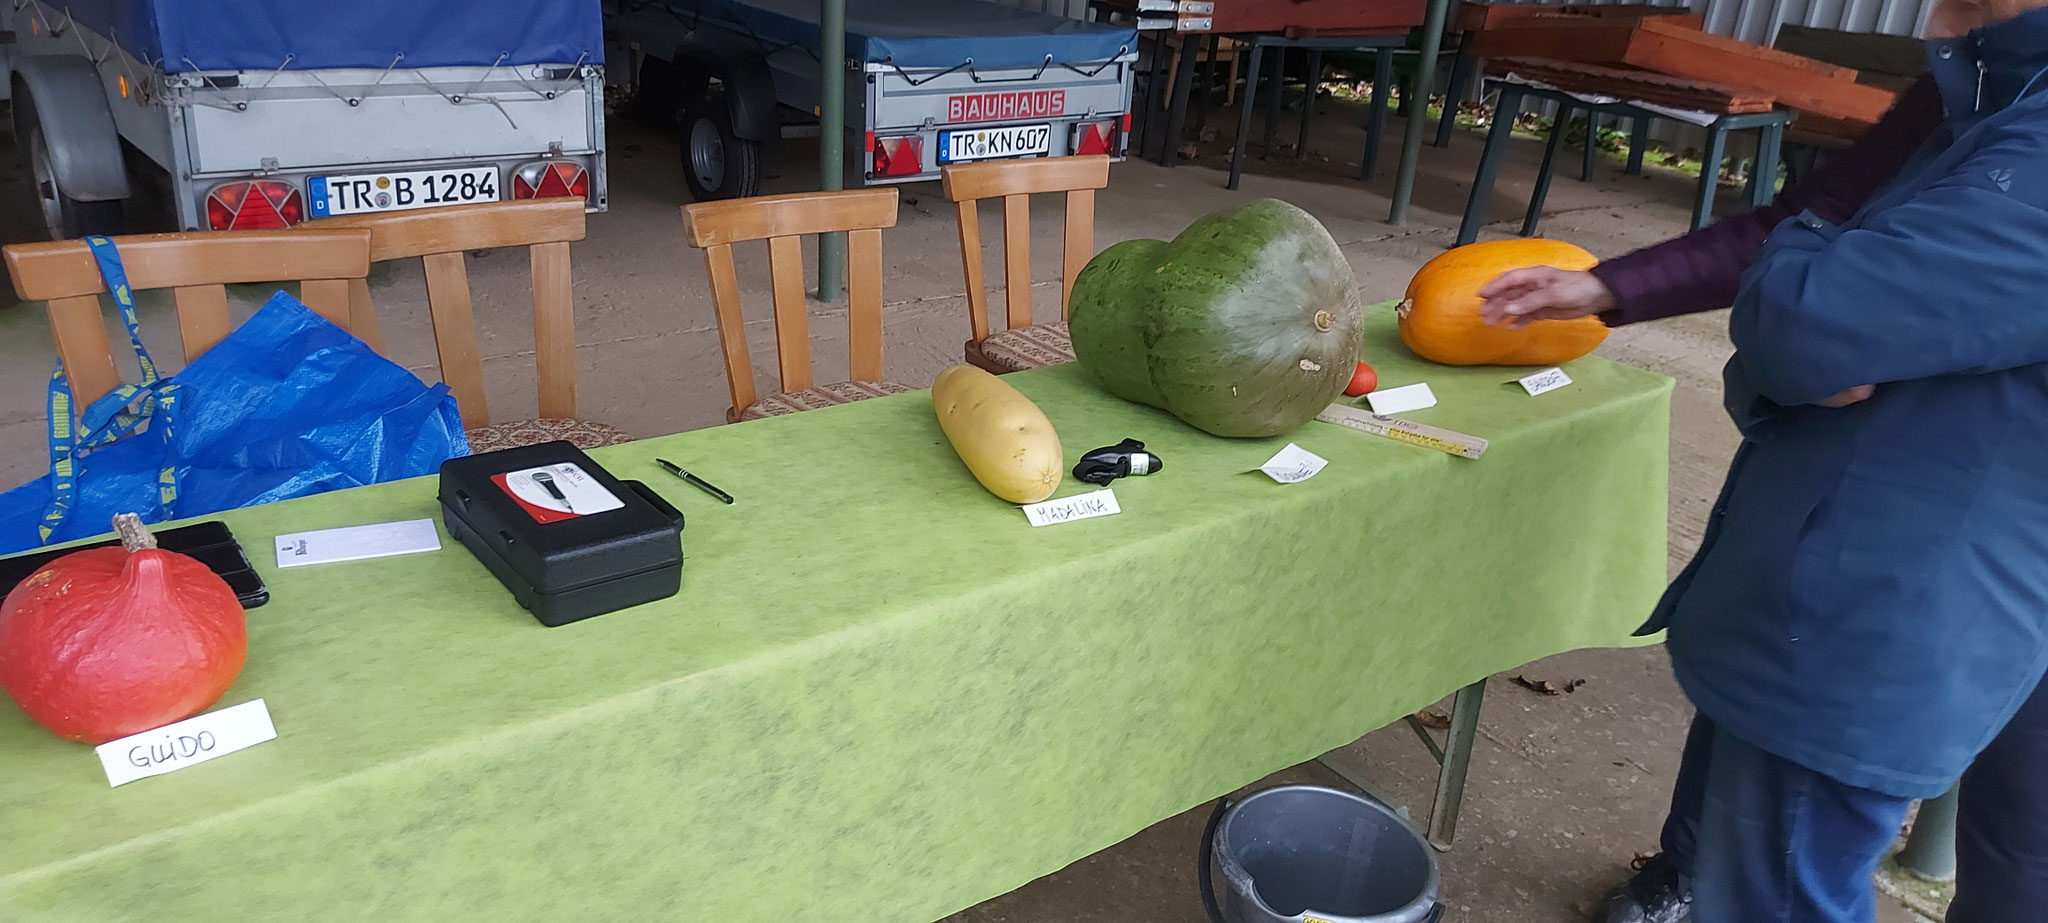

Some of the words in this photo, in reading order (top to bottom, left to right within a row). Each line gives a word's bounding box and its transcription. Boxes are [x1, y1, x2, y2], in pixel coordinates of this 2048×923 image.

[950, 93, 1064, 119] BAUHAUS
[952, 134, 975, 157] TR
[988, 130, 1012, 154] KN
[1016, 127, 1048, 151] 607
[331, 180, 374, 210] TR
[395, 177, 415, 206] B
[422, 171, 495, 204] 1284
[316, 200, 325, 210] D
